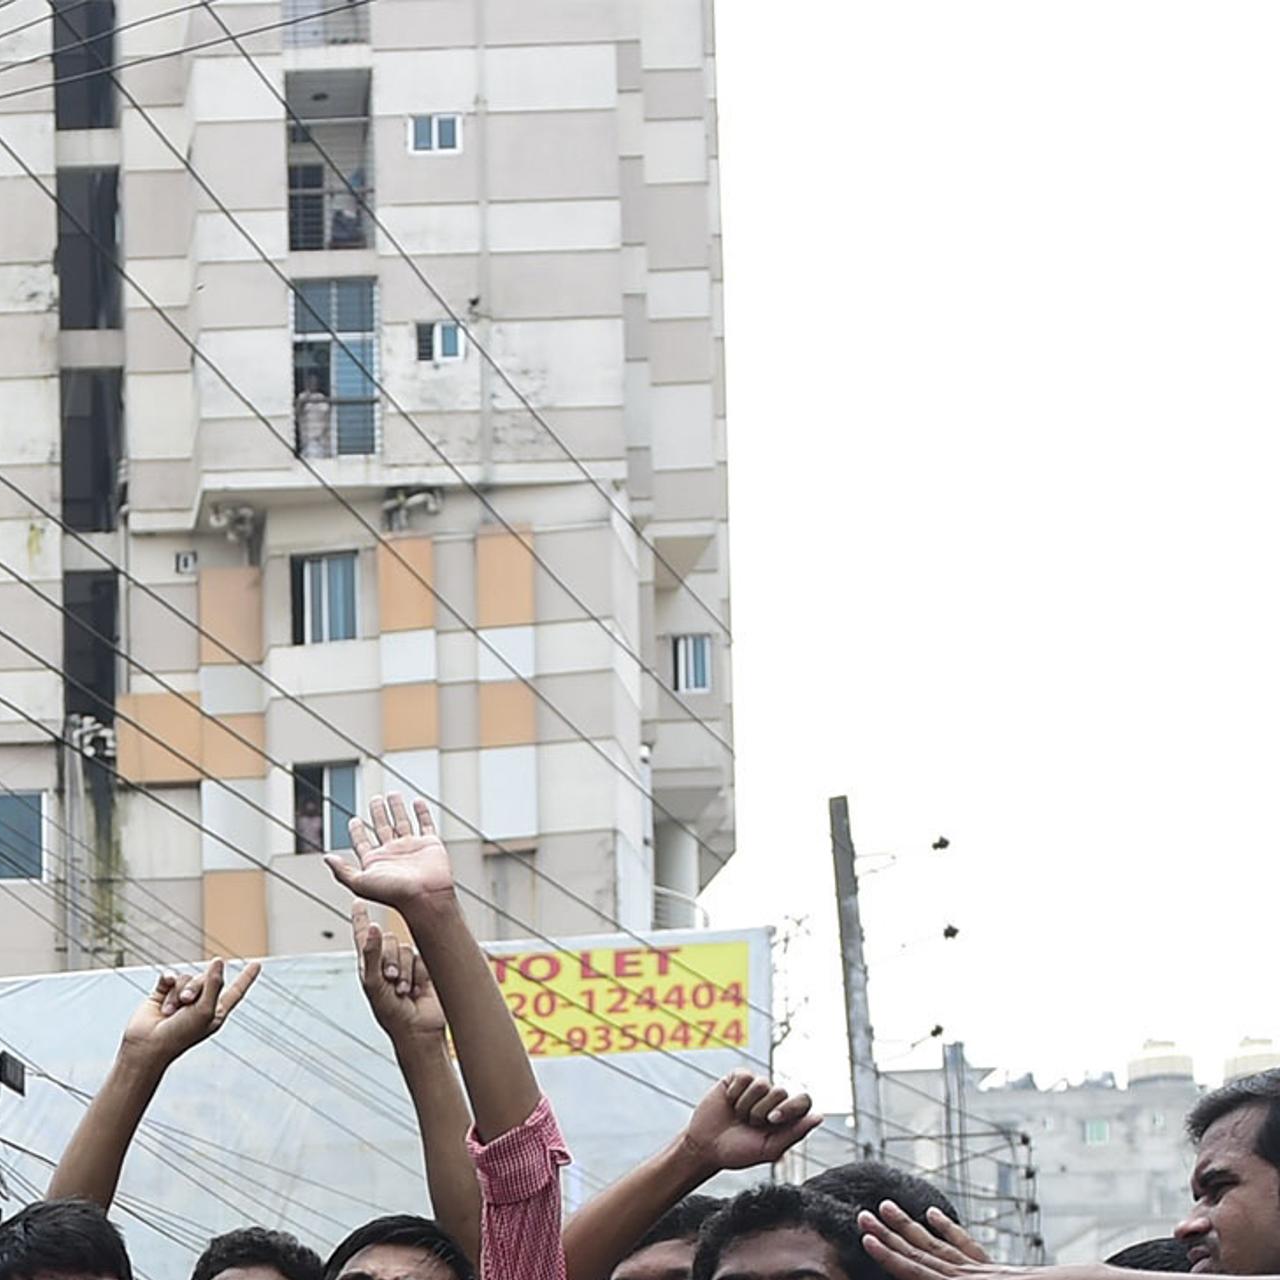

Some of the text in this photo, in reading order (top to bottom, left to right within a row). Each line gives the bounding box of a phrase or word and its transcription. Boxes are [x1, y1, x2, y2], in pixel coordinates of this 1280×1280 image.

[493, 947, 682, 983] TO LET
[505, 982, 744, 1018] 20-124404
[527, 1020, 744, 1055] 2-9350474
